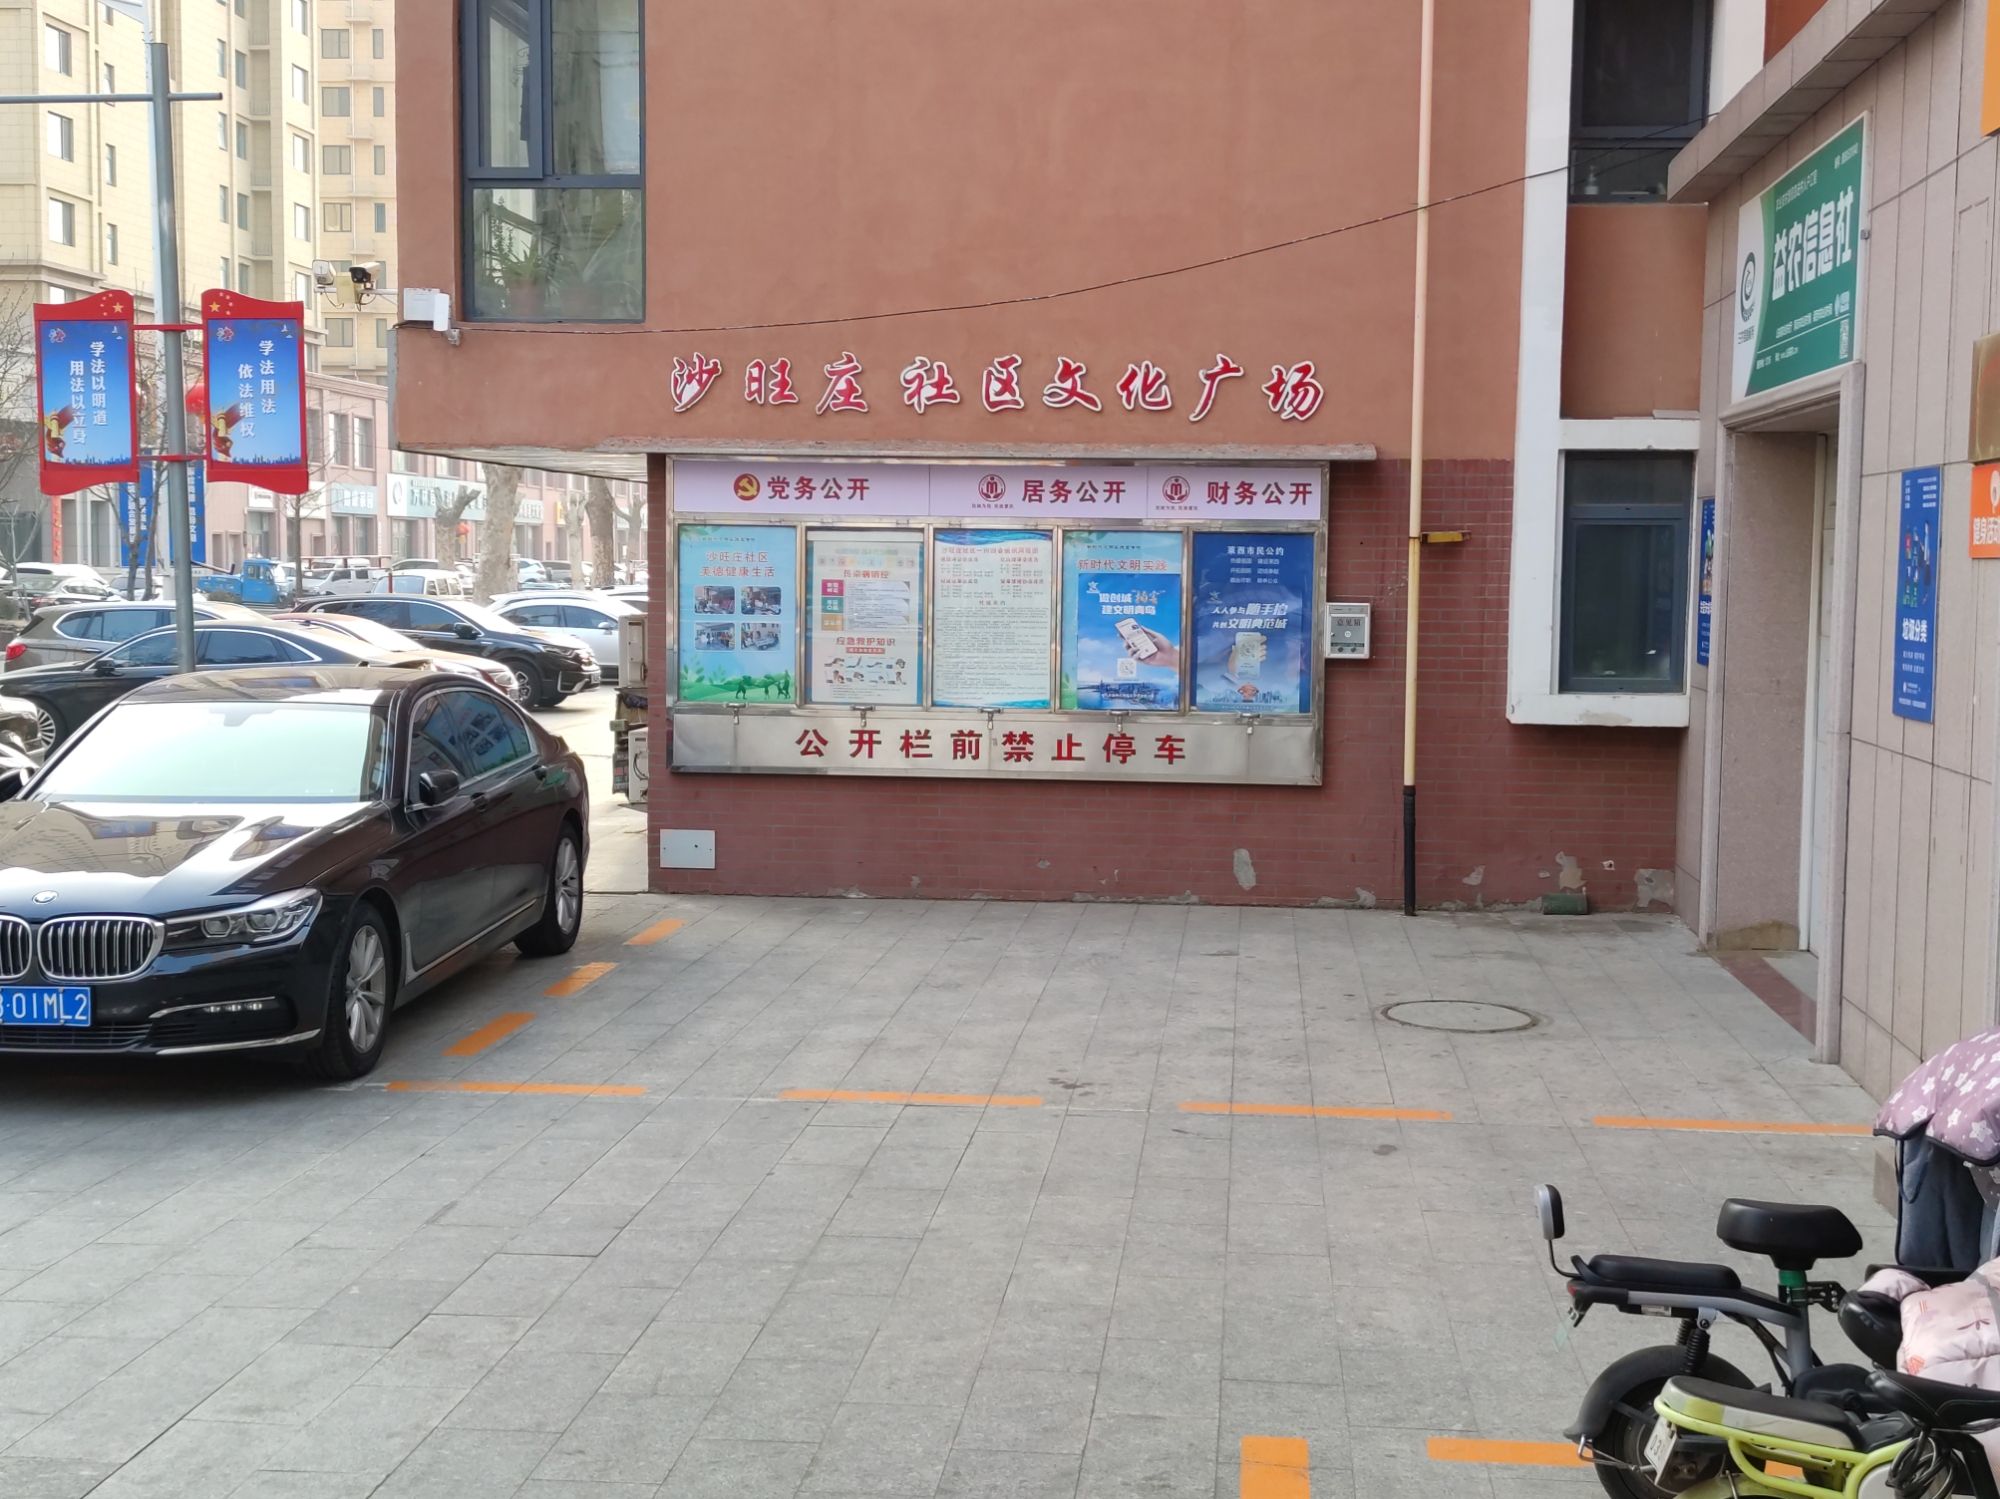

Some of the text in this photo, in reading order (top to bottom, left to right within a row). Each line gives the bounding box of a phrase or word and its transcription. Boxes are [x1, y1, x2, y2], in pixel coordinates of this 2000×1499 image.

[1771, 185, 1854, 301] 益农信息社
[69, 360, 87, 444] 用法以立身
[89, 341, 107, 426] 学法以明道
[237, 363, 256, 438] 依法维权
[258, 339, 276, 414] 学法用法
[671, 351, 1324, 422] 沙旺庄社区文化广场
[766, 475, 871, 501] 党务公开
[1021, 479, 1127, 504] 居务公开
[1206, 480, 1314, 506] 财务公开
[706, 551, 769, 563] 沙旺庄社区
[1077, 559, 1168, 572] 新时代文明实践
[795, 728, 1188, 765] 公开栏前禁止停车
